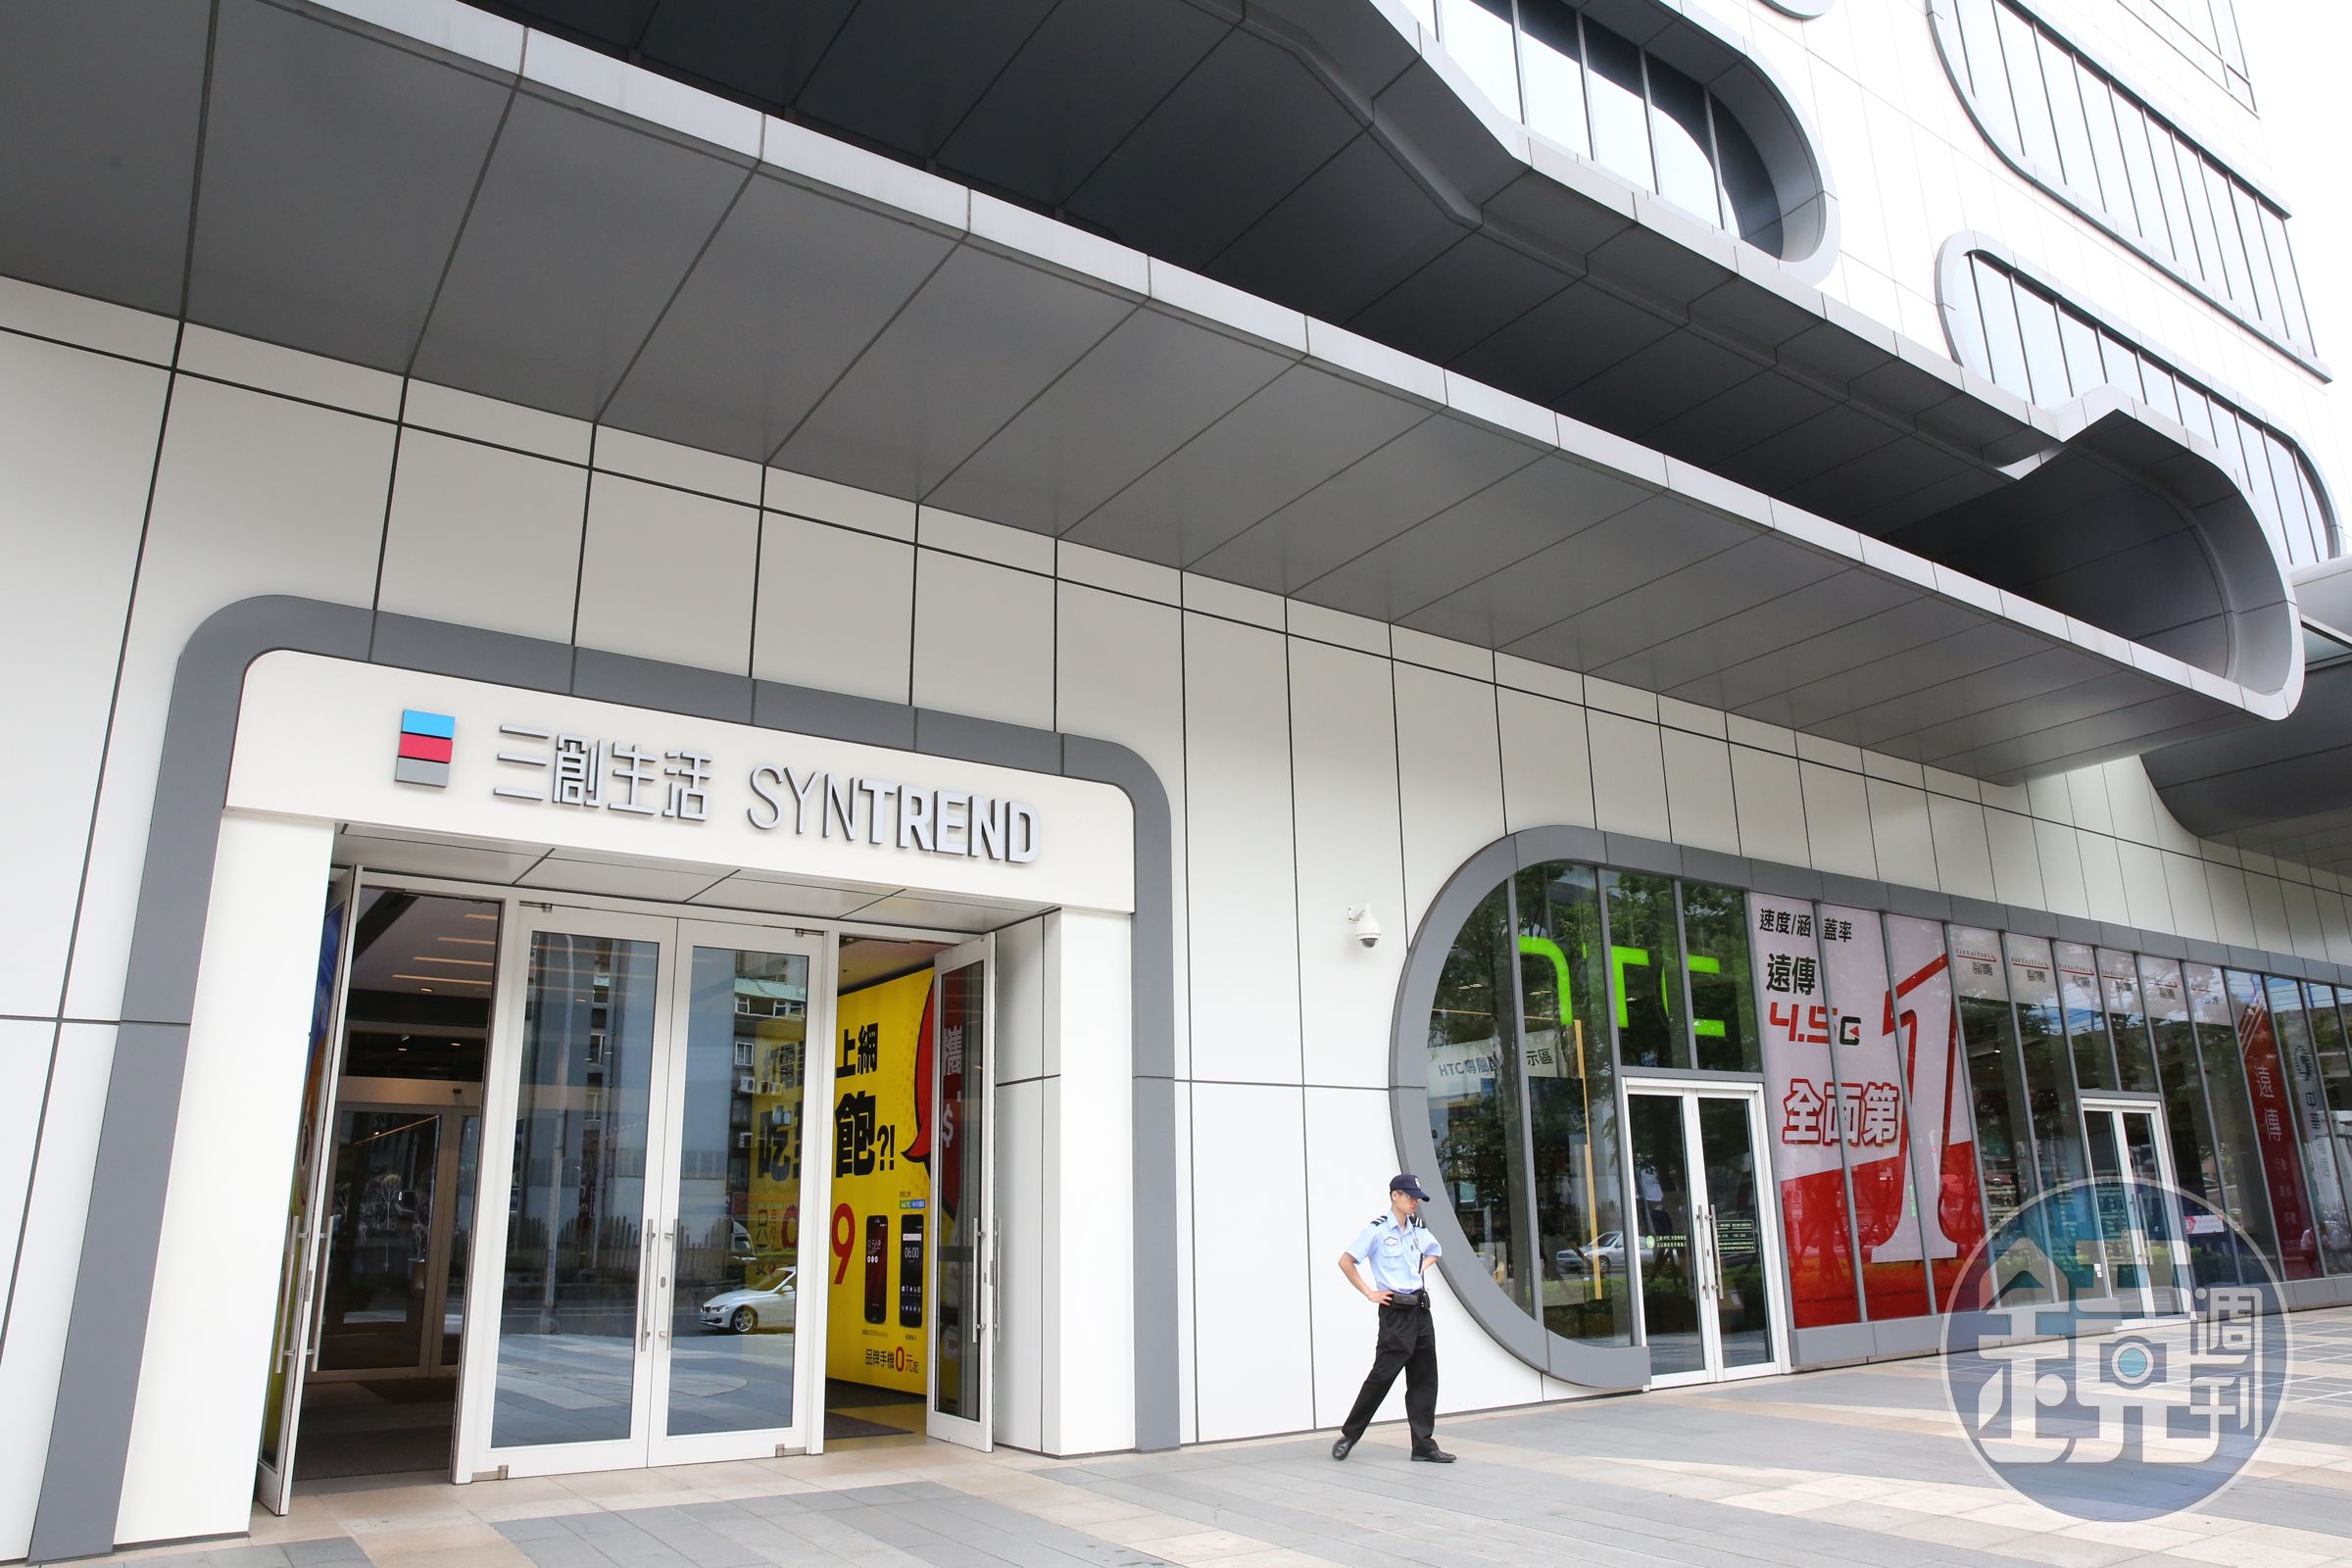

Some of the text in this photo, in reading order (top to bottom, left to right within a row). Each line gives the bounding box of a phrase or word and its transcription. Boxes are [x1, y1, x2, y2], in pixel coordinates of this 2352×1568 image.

[494, 723, 713, 822] 三創生活
[748, 760, 1043, 864] SYNTREND
[1766, 953, 1816, 997] 遠傳
[836, 1022, 879, 1078] 上網
